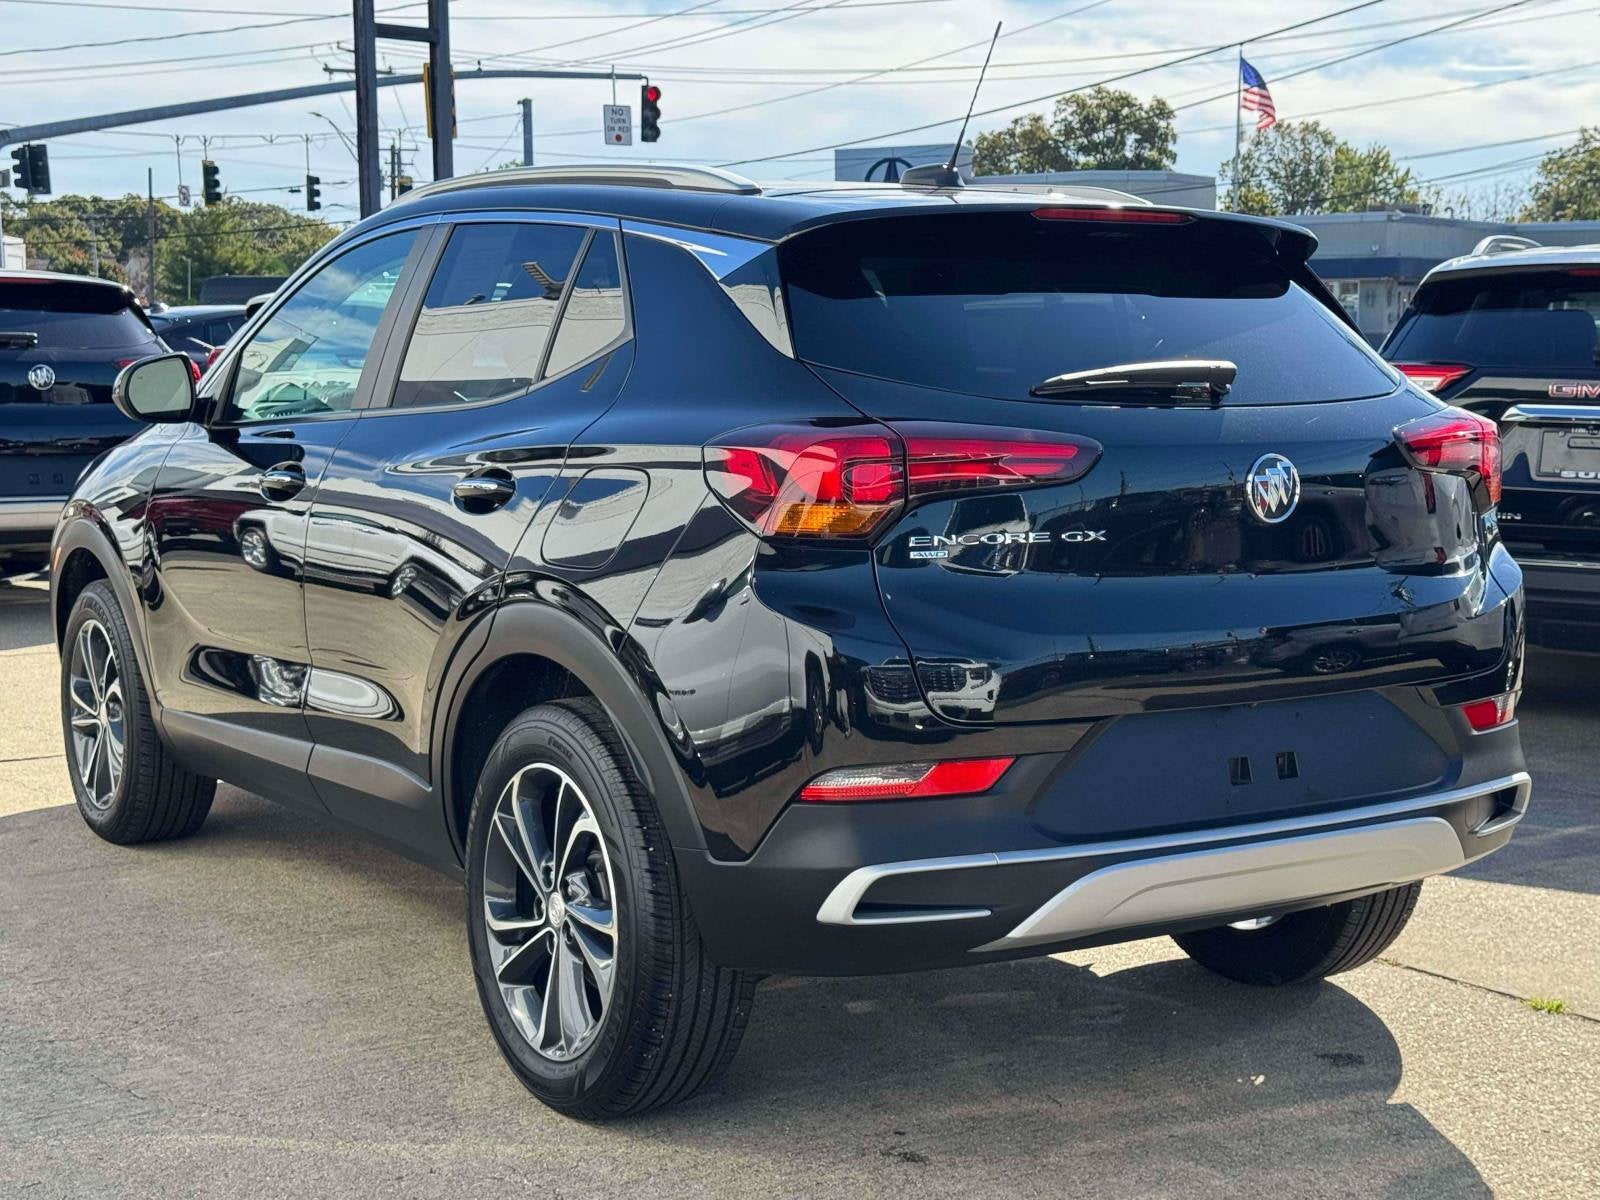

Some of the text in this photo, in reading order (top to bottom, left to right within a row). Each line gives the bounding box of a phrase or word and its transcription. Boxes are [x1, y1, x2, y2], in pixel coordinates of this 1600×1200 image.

[610, 108, 623, 116] NO
[908, 530, 1107, 547] ENCORE GX
